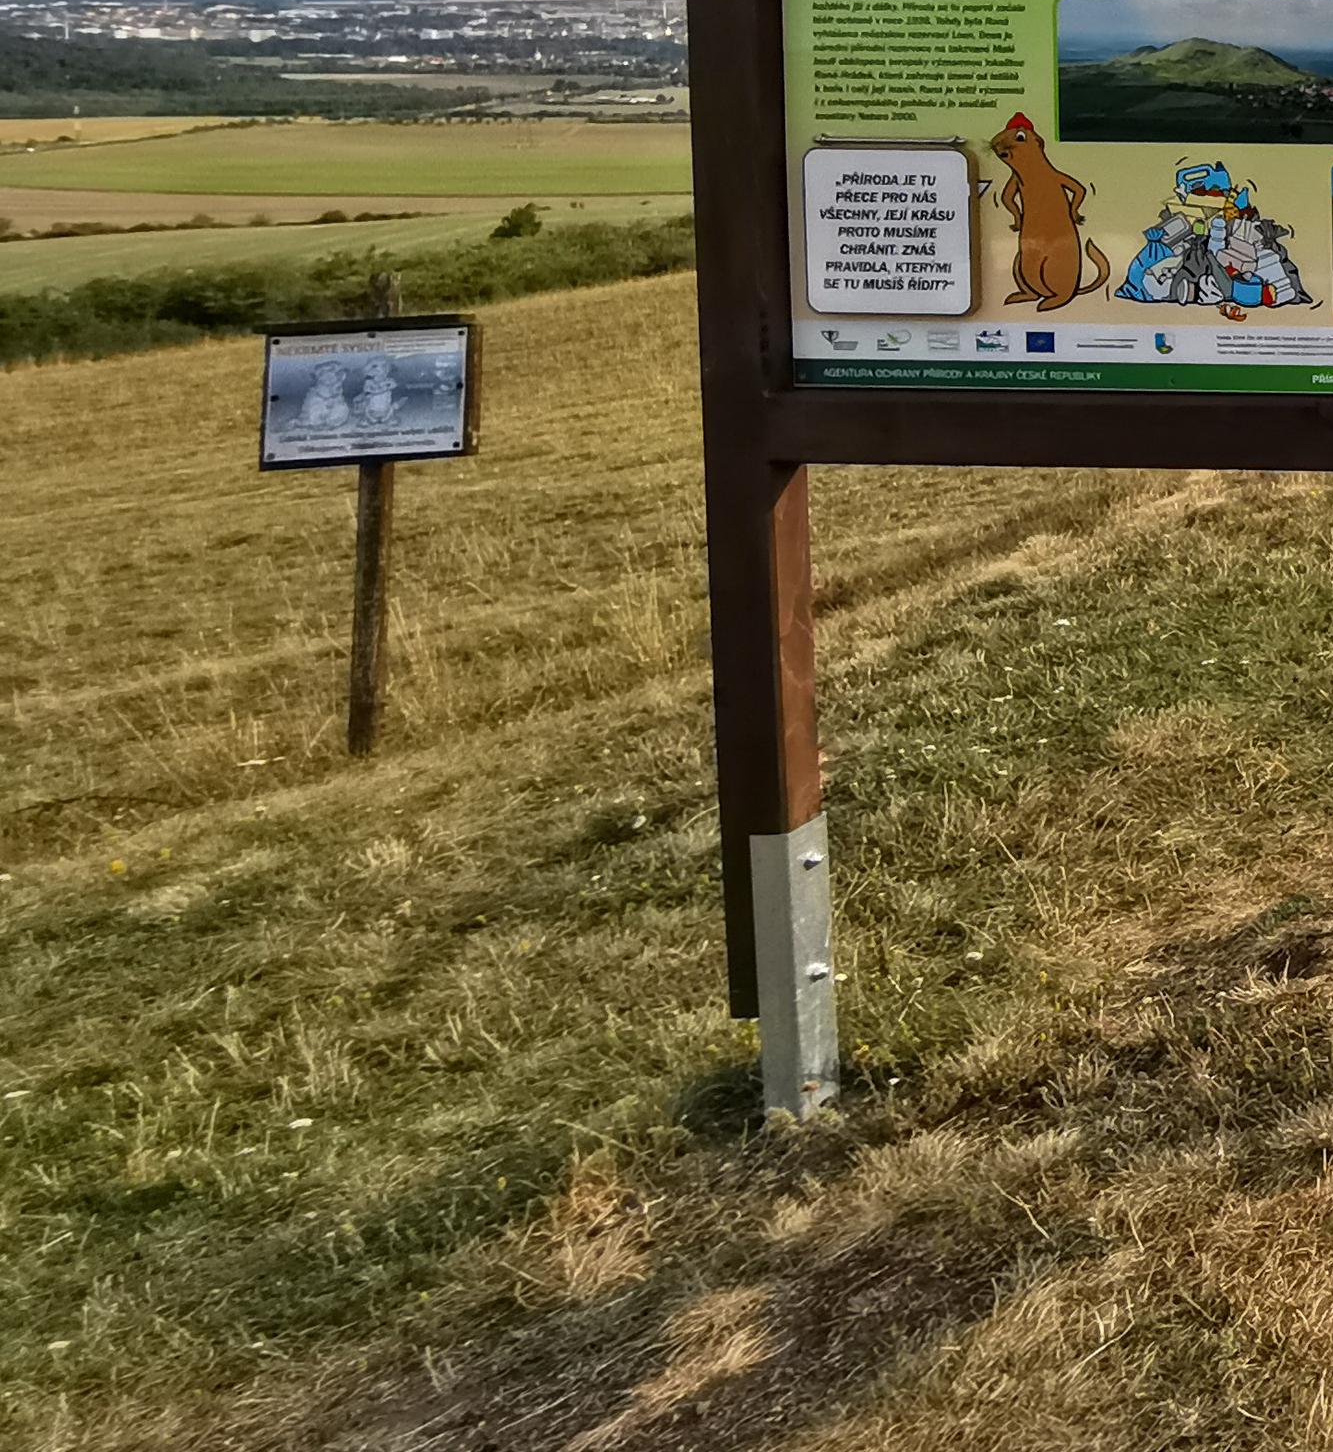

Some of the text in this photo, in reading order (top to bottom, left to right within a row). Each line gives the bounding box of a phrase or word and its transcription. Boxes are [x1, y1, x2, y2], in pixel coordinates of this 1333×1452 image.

[903, 175, 917, 186] JE
[921, 175, 936, 186] TU
[836, 190, 937, 203] PŘECE PRO NÁS
[819, 206, 955, 222] VŠECHNY, JEJÍ KRÁSU
[838, 225, 937, 238] PROTO MUSÍME
[839, 242, 936, 256] CHRÁNIT. ZNÁŠ
[826, 260, 952, 275] PRAVIDLA, KTERÝMI
[824, 279, 841, 289] SE
[844, 279, 859, 290] TU
[863, 276, 904, 290] MUSÍŠ
[823, 367, 873, 379] AGENTURA
[875, 368, 921, 379] OCHRANY
[1016, 367, 1047, 381] ČESKÉ
[1050, 370, 1102, 382] REPUBLIKY
